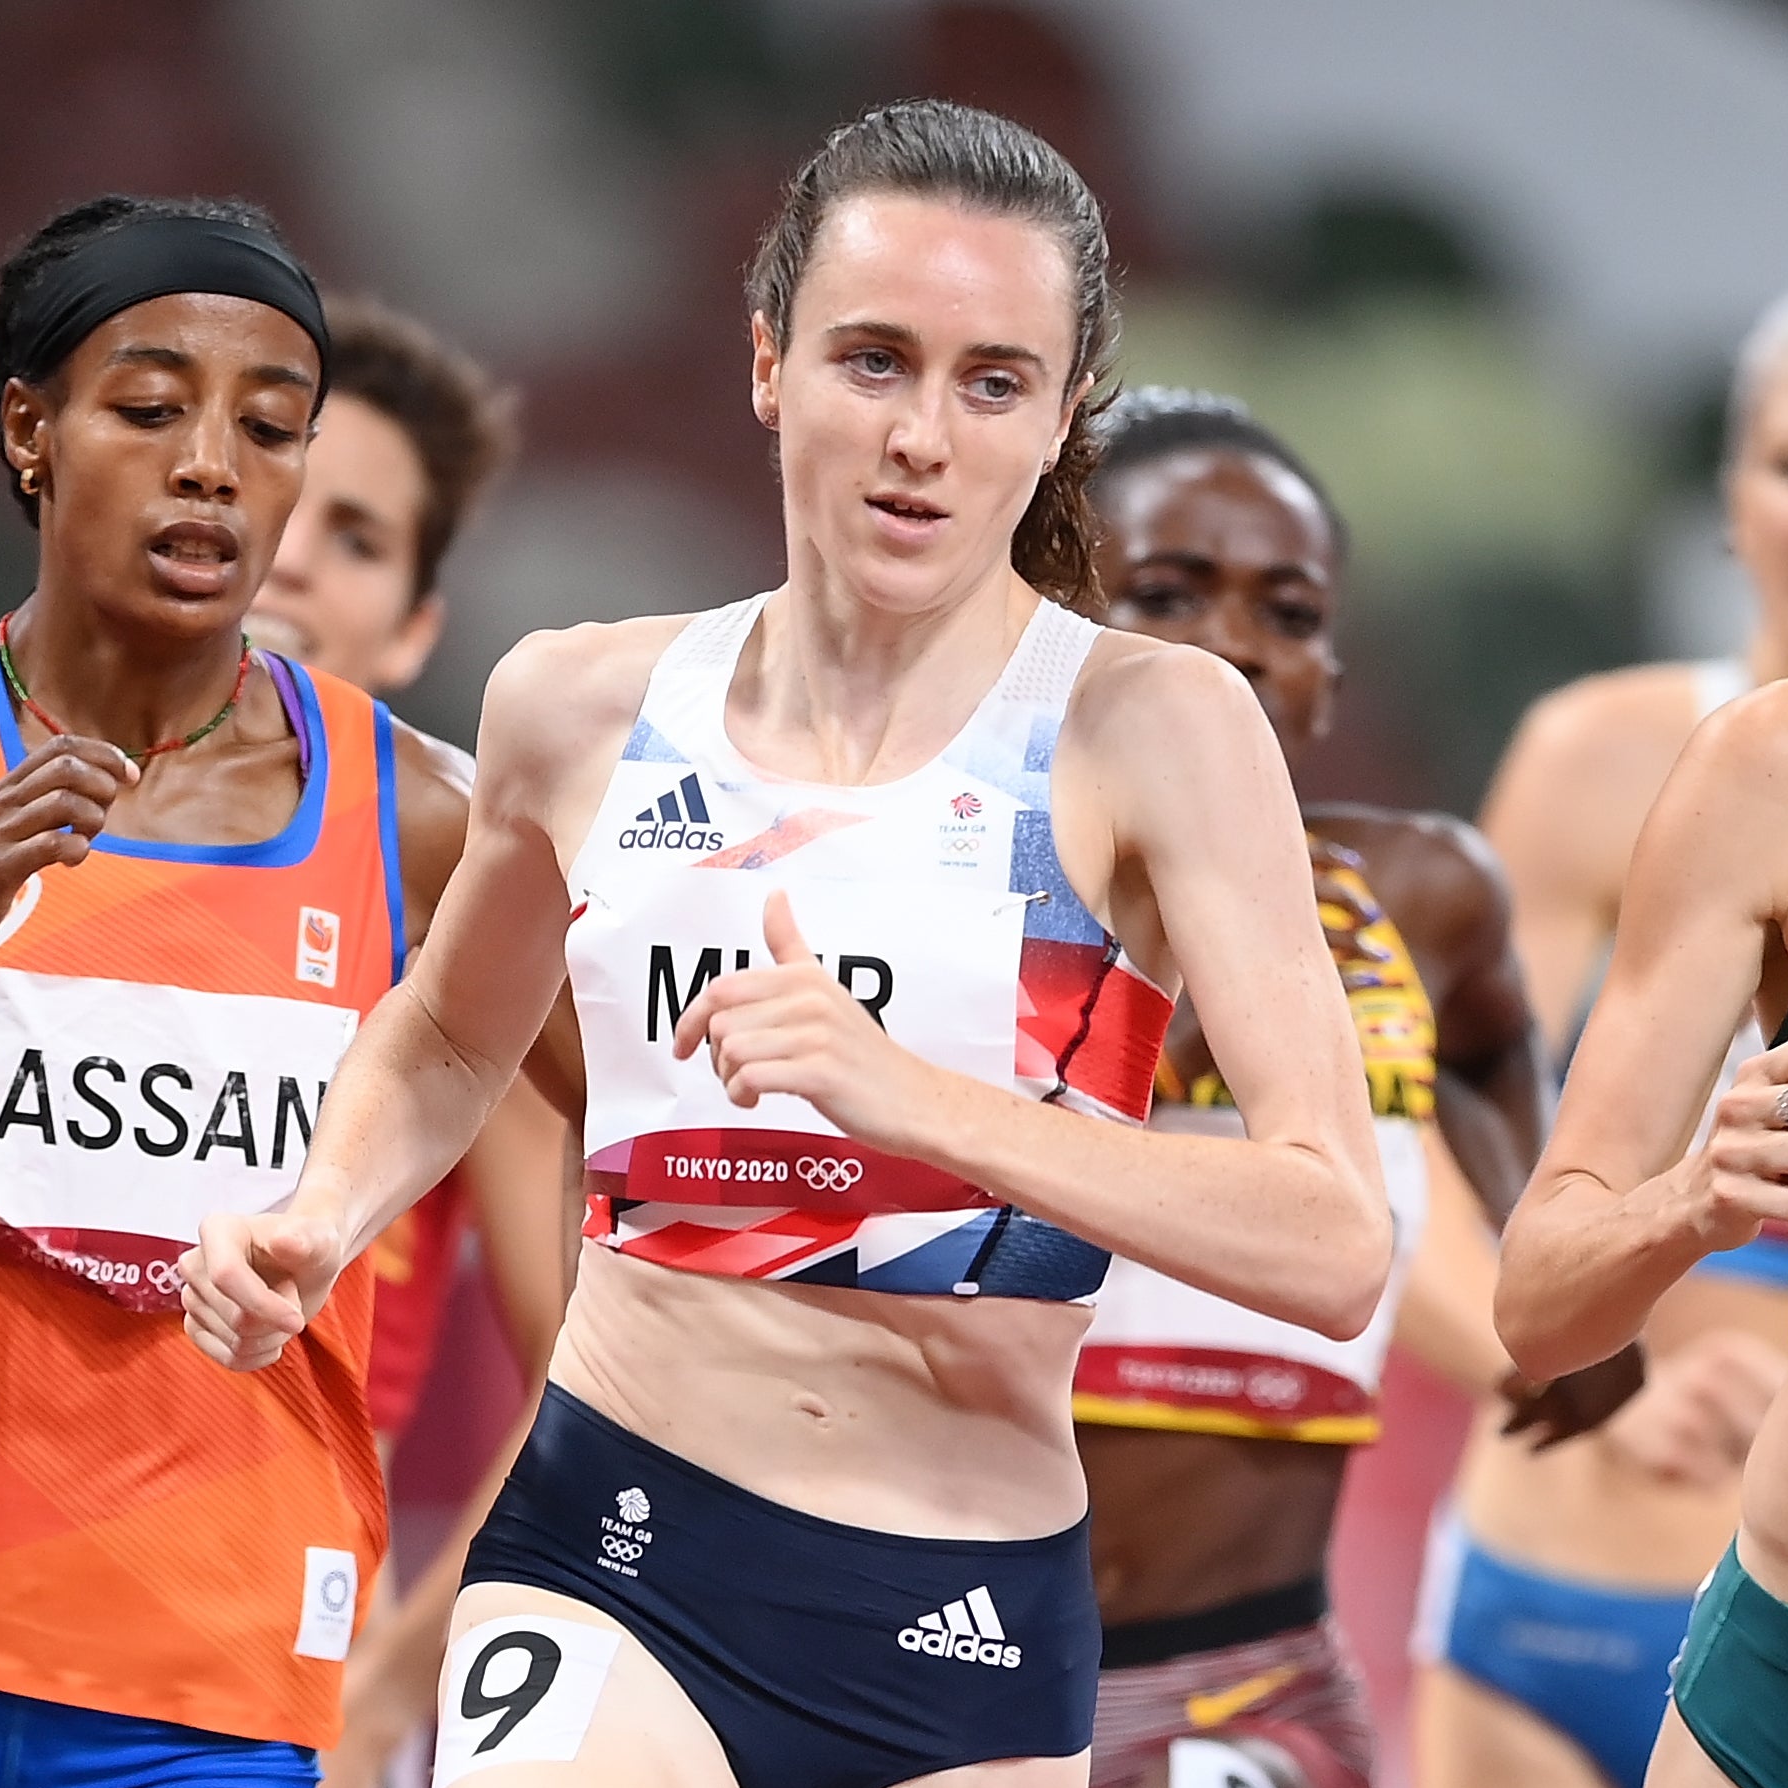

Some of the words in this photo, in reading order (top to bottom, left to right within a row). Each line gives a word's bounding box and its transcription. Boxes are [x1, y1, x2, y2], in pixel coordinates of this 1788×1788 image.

[619, 821, 724, 851] adidas
[647, 944, 893, 1045] MR
[664, 1156, 732, 1181] TOKYO
[734, 1160, 789, 1182] 2020
[86, 1260, 141, 1286] 2020
[601, 1516, 633, 1537] TEAM
[635, 1528, 653, 1544] GB
[897, 1627, 1022, 1669] adidas
[460, 1630, 562, 1758] 9
